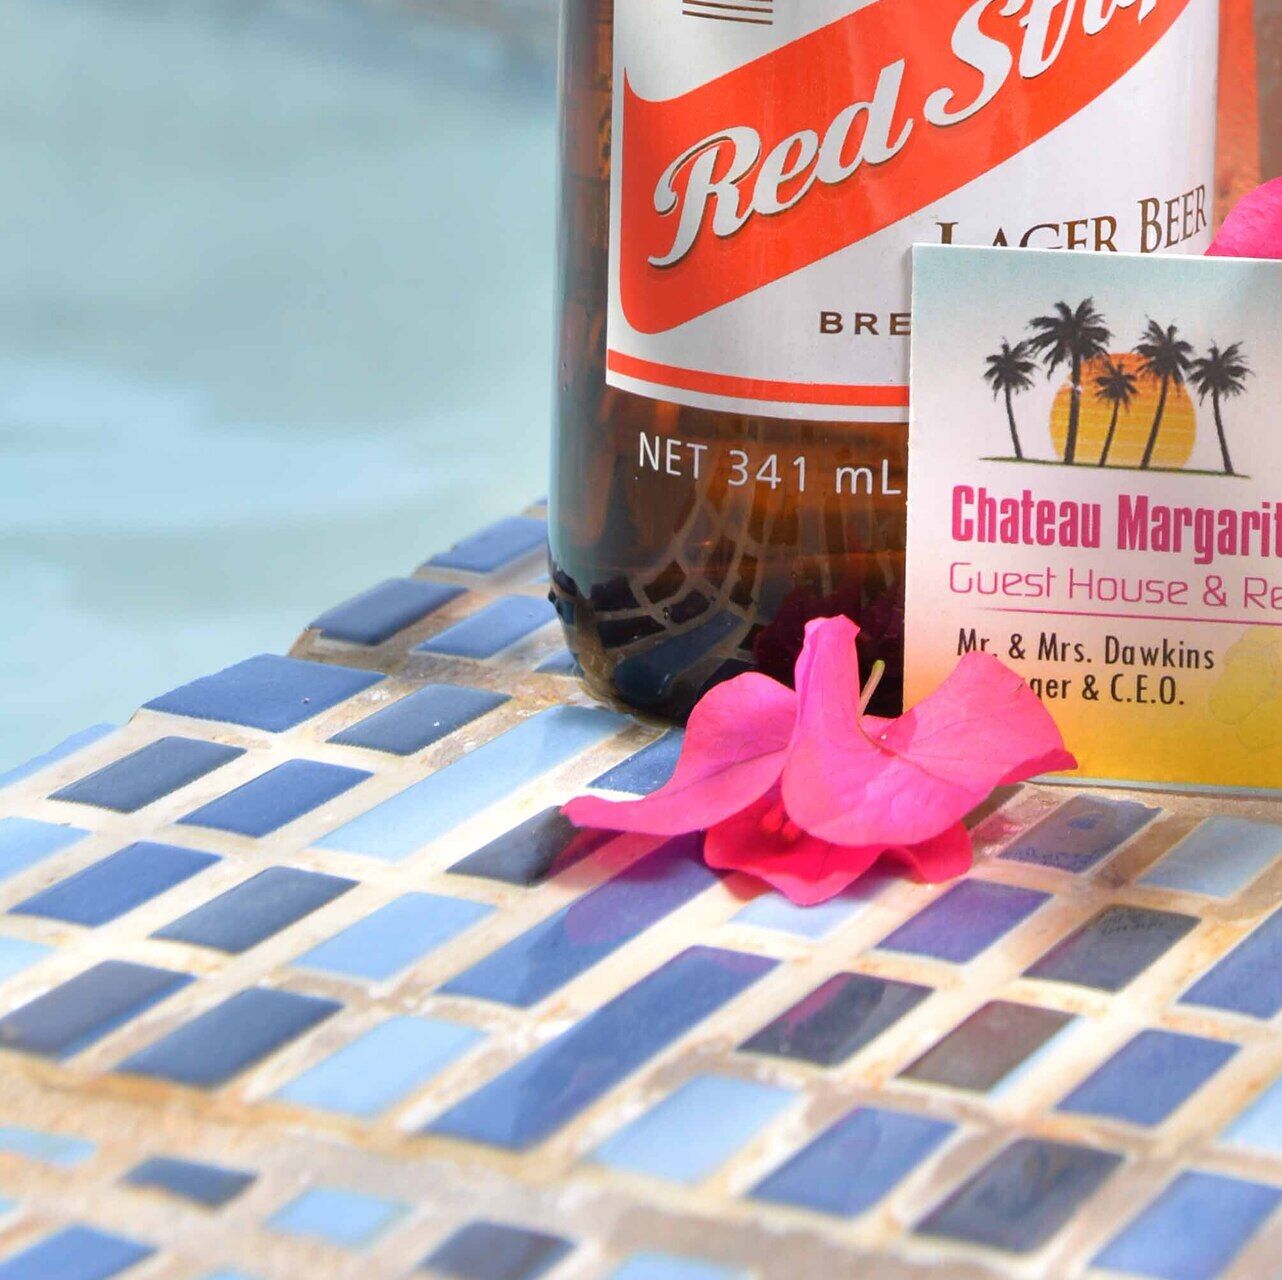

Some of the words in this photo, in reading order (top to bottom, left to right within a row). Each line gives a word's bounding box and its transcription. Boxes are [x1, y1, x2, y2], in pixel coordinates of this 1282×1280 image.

[648, 57, 914, 268] Red
[1138, 185, 1207, 254] BEER
[639, 432, 708, 480] NET
[728, 450, 806, 492] 341
[836, 459, 902, 495] mL
[952, 485, 1101, 549] Chateau
[949, 562, 1057, 599] Guest
[1069, 567, 1188, 606] House
[1202, 575, 1228, 608] &
[1008, 633, 1025, 660] &
[1038, 632, 1092, 663] Mrs.
[1105, 635, 1215, 670] Dawkins
[1082, 674, 1099, 701] &
[1110, 673, 1185, 705] C.E.O.
